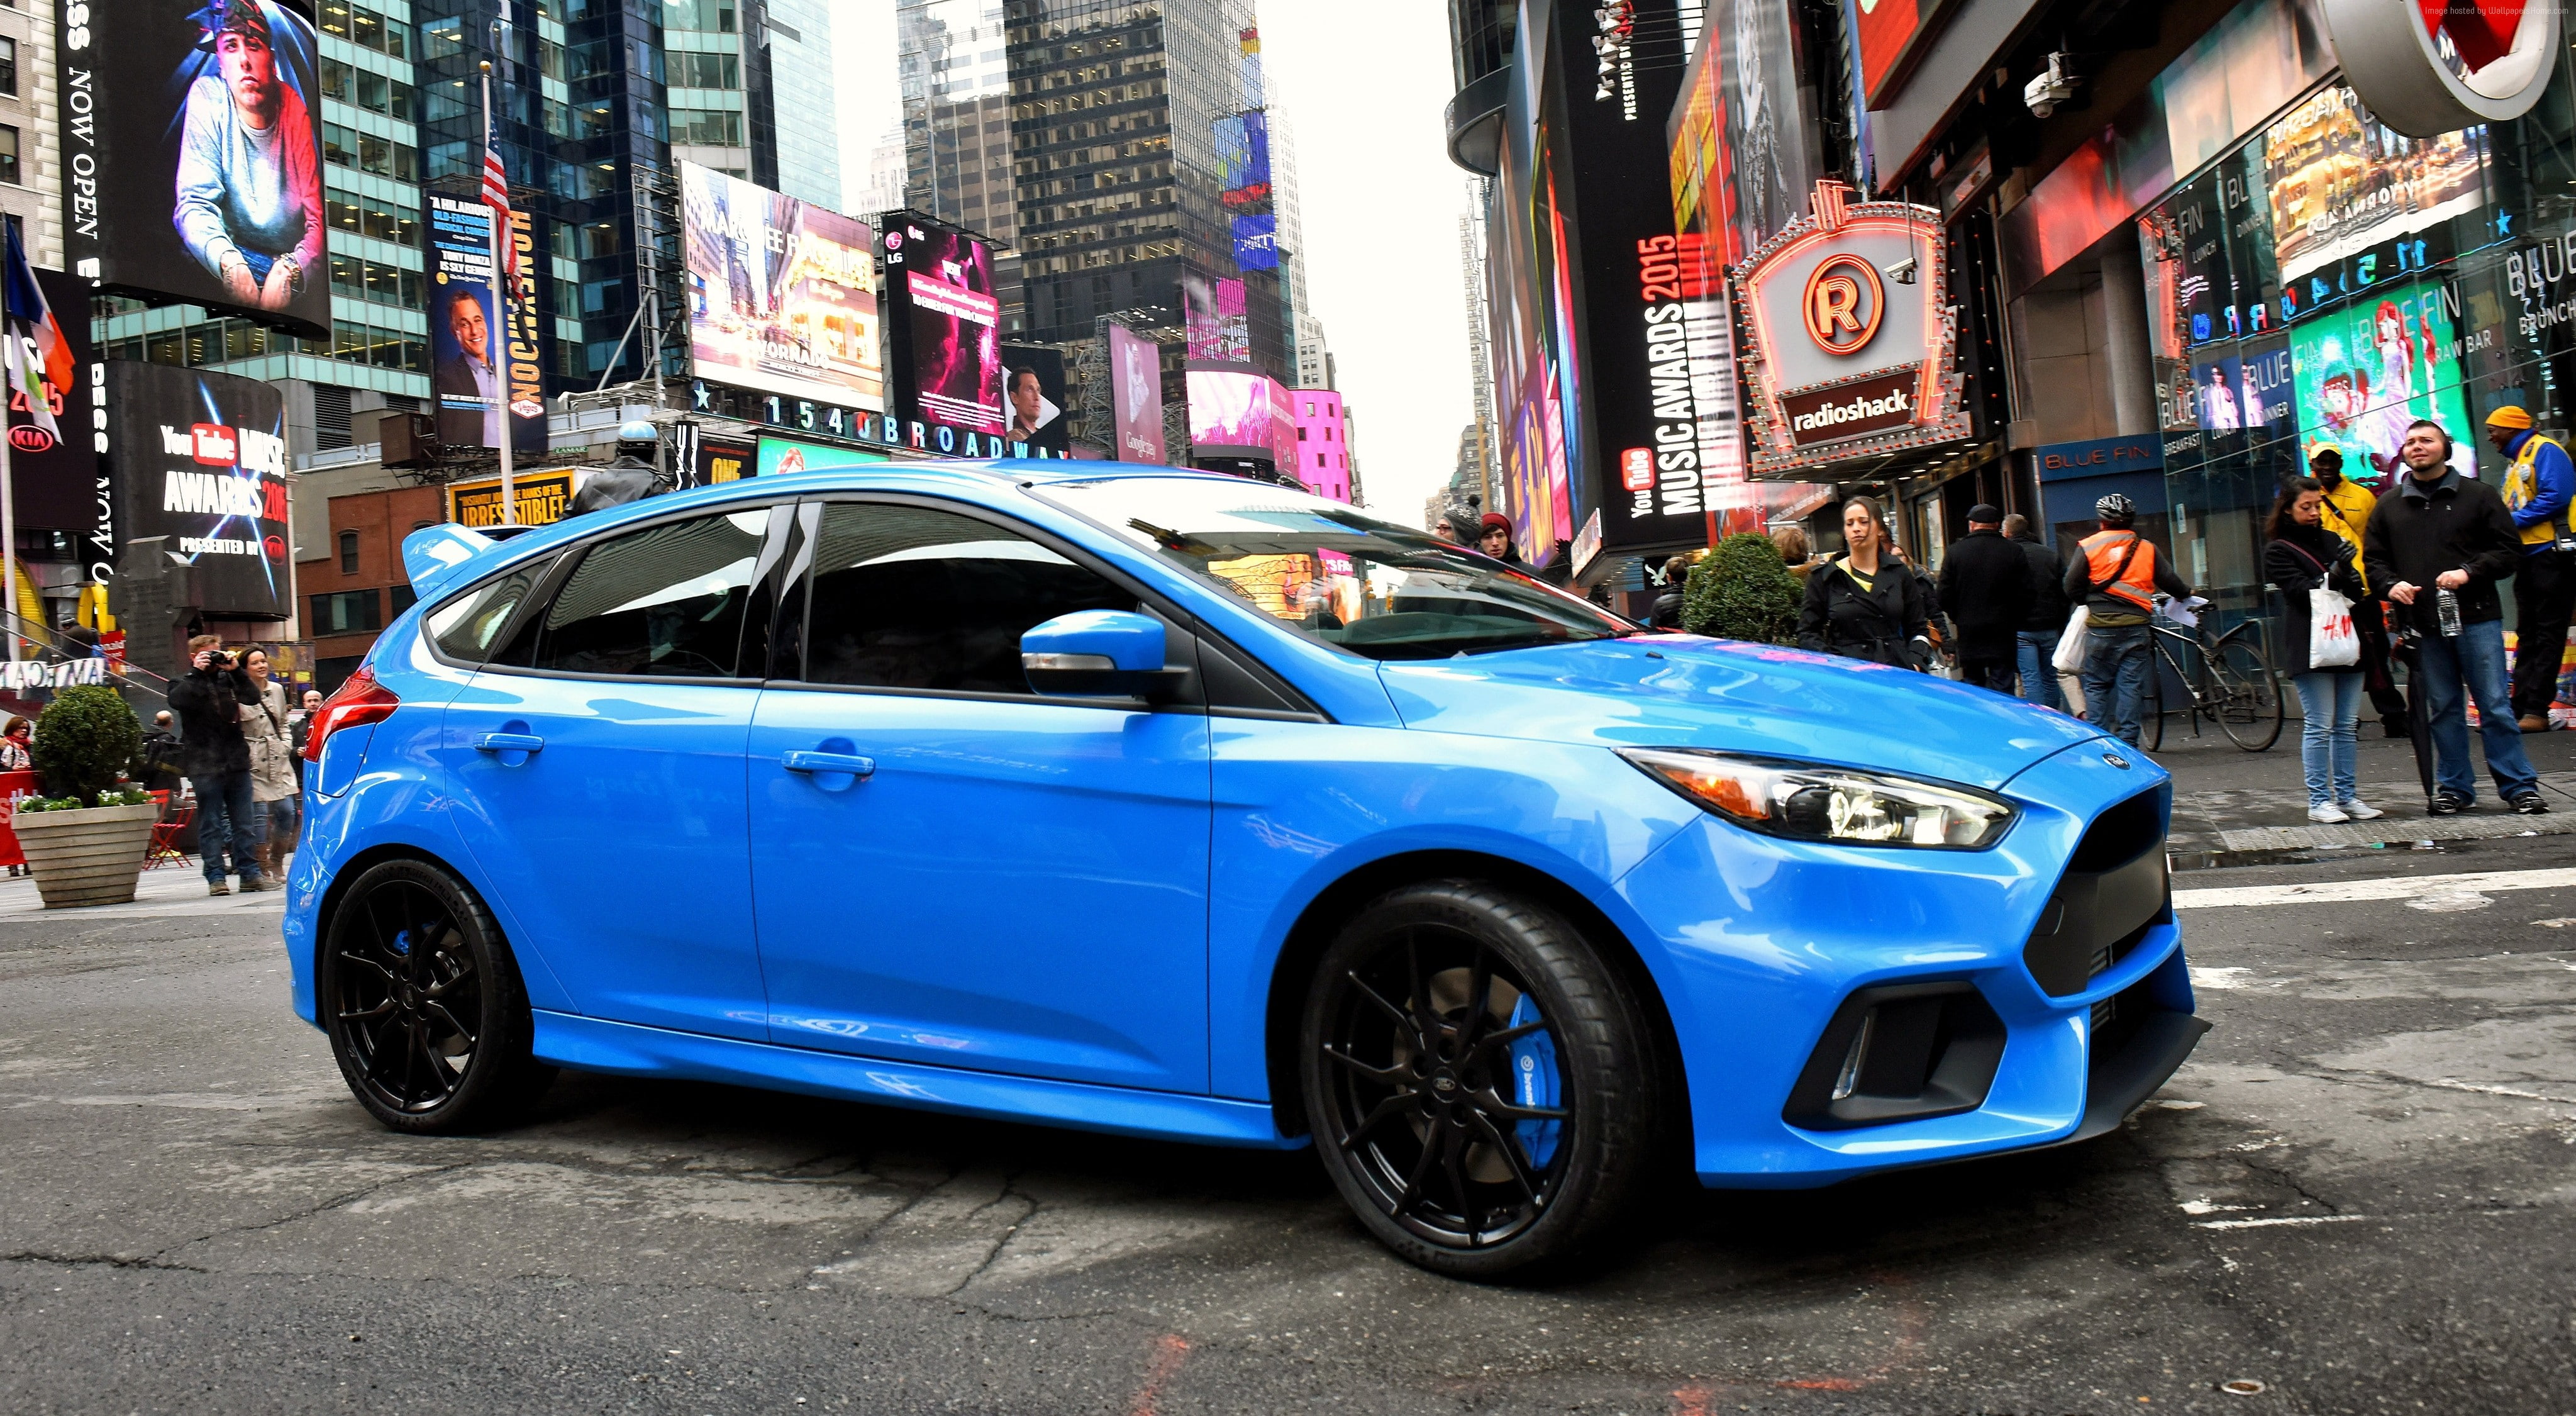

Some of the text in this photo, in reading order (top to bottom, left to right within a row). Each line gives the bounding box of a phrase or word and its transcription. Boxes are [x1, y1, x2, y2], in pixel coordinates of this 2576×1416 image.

[67, 0, 91, 51] SS
[69, 66, 94, 147] NOW
[72, 153, 98, 240] OPEN
[887, 252, 903, 264] LG
[1637, 235, 1681, 301] 2015
[2465, 330, 2493, 354] BAR
[2246, 350, 2290, 396] BLUE
[768, 396, 871, 439] 1540
[1644, 303, 1702, 516] MUSIC AWARDS
[1794, 388, 1909, 432] radioshack
[14, 430, 46, 447] KIA
[2045, 445, 2150, 469] BLUE FIN
[164, 471, 263, 518] AWARDS
[1523, 1072, 1536, 1106] bremb
